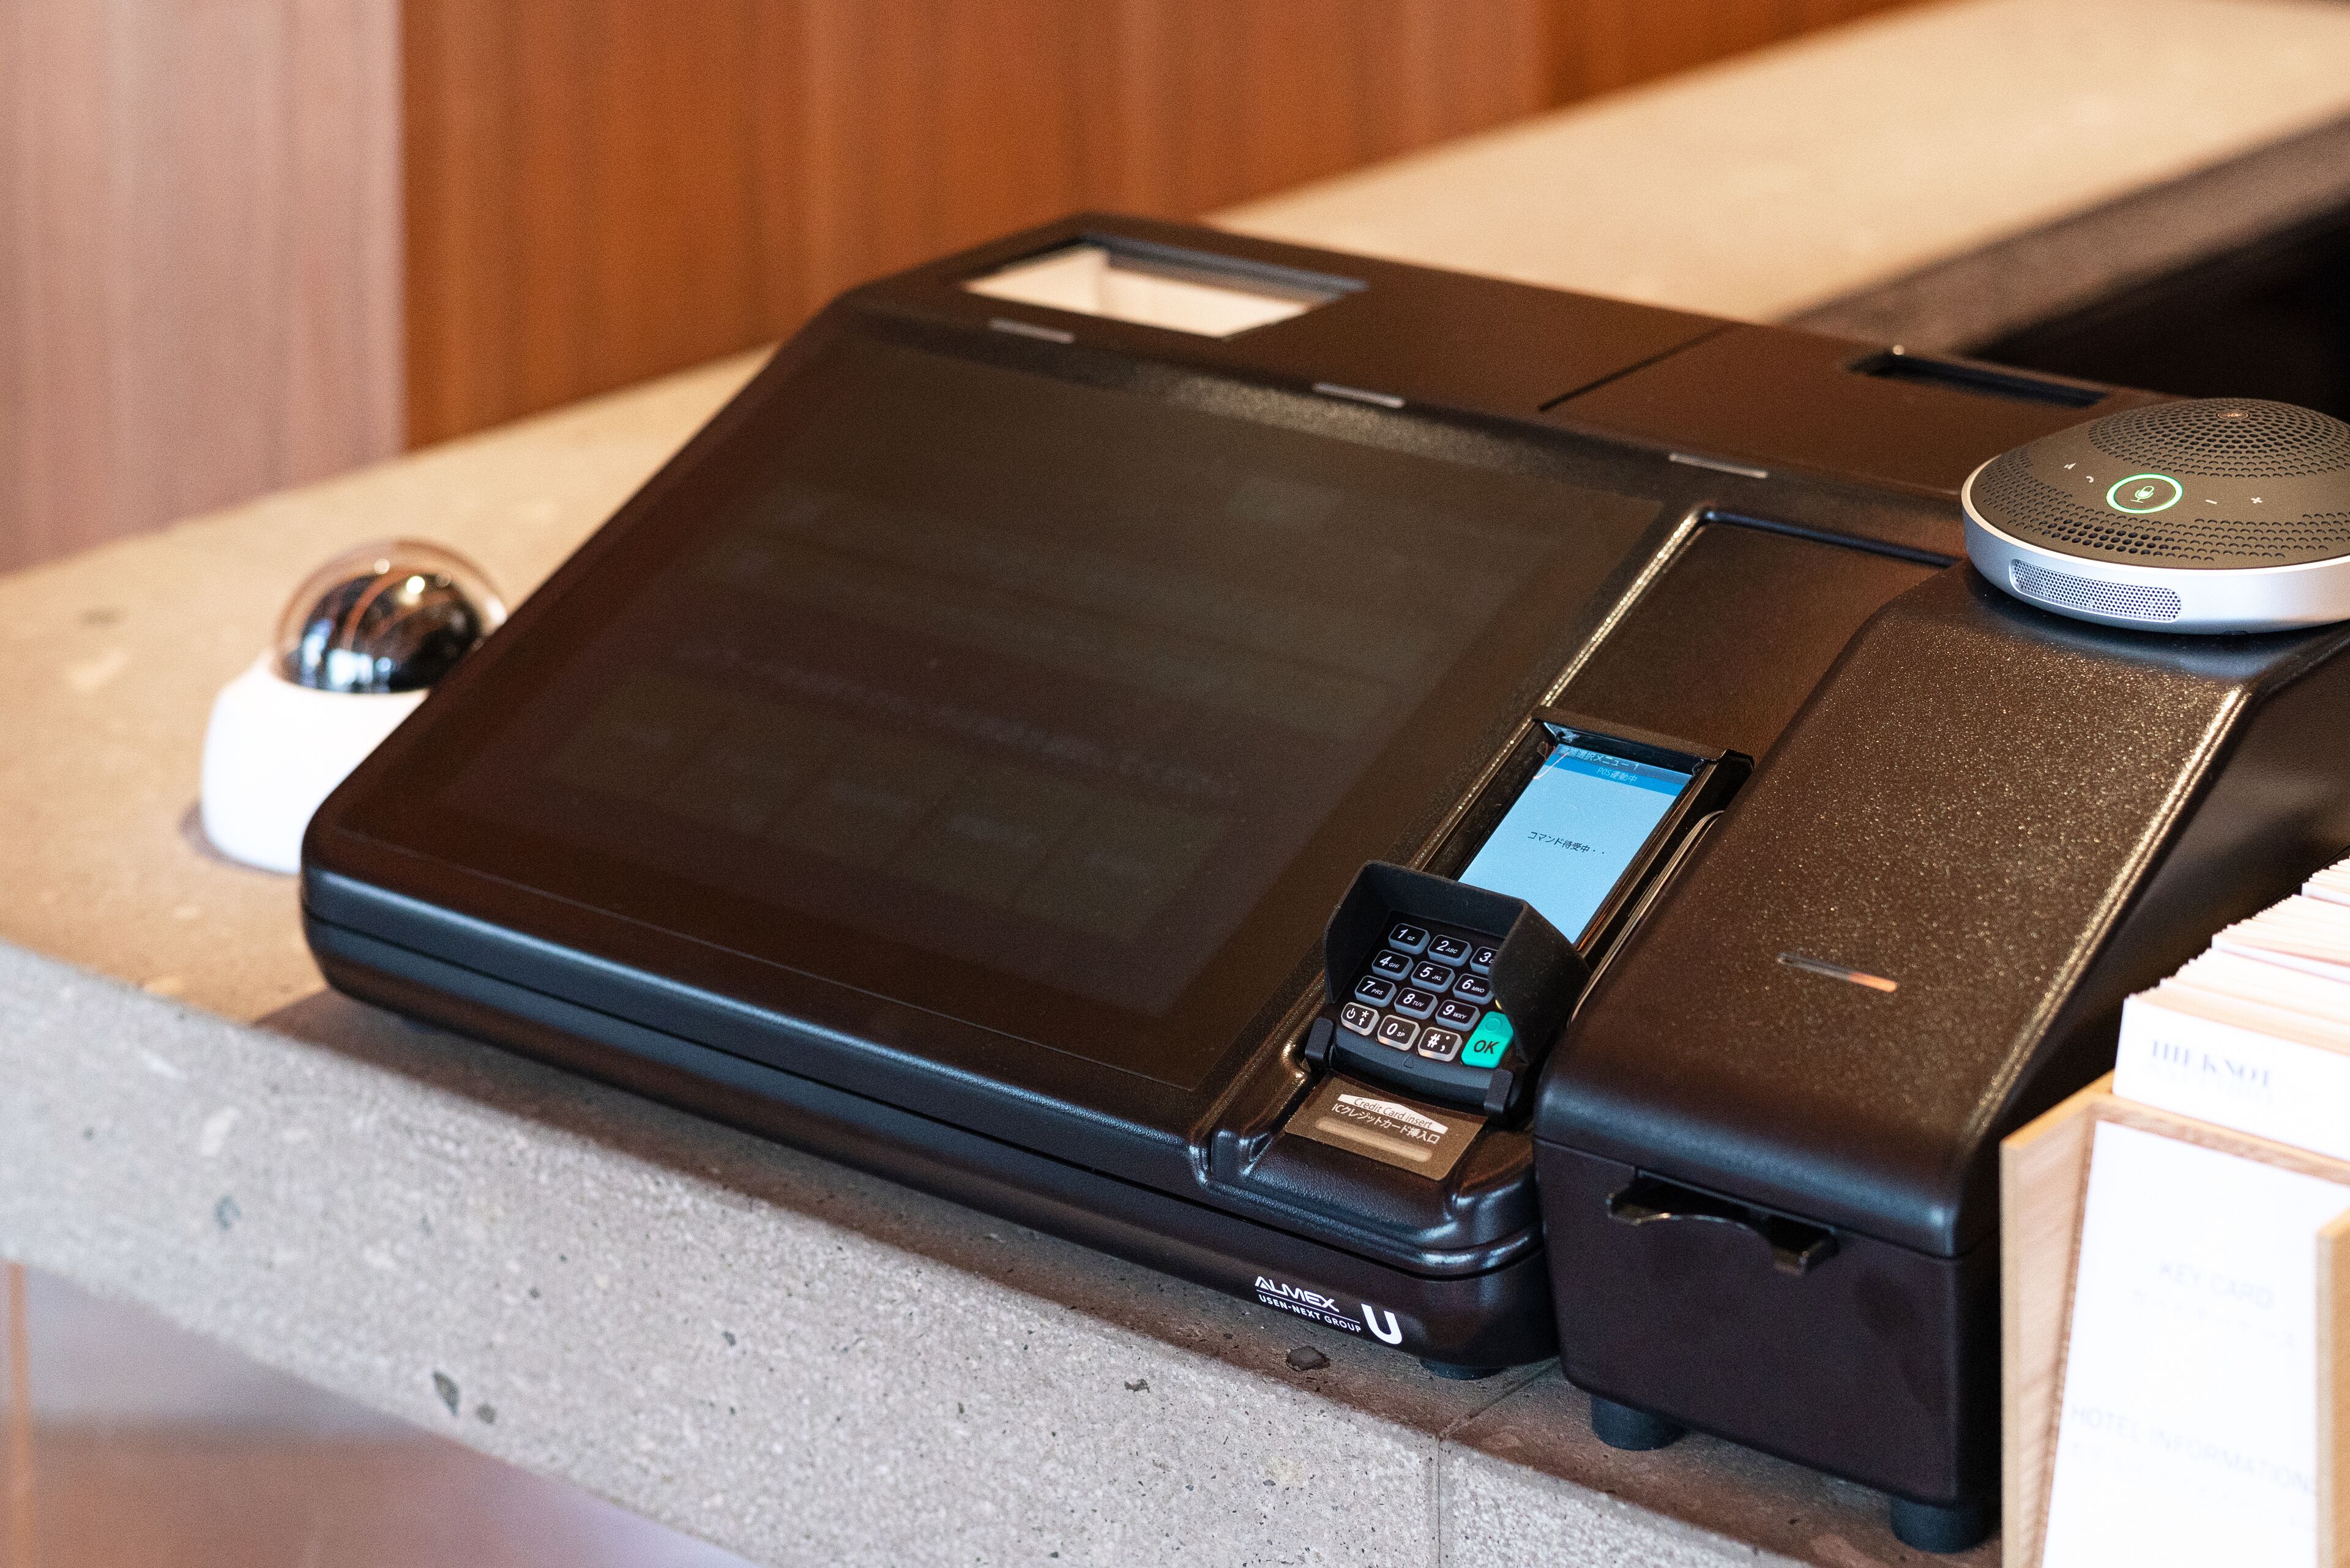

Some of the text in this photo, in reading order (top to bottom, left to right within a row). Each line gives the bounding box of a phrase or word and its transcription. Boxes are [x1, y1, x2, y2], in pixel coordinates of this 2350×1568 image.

[1398, 929, 1408, 939] 1
[1436, 941, 1450, 952] 2
[1379, 956, 1392, 966] 4
[1479, 952, 1491, 963] 3
[1420, 966, 1432, 977] 5
[1361, 980, 1375, 992] 7
[1462, 979, 1472, 990] 6
[1403, 994, 1415, 1004] 8
[1443, 1005, 1454, 1015] 9
[1387, 1023, 1397, 1035] 0
[1473, 1040, 1500, 1055] OK
[1354, 1097, 1433, 1129] Credit Card insert
[1332, 1102, 1441, 1145] ICクレジットカード挿入口
[1255, 1276, 1339, 1312] ALMEX
[1258, 1294, 1362, 1333] USEN-NEXT GROUP
[1361, 1304, 1402, 1344] U
